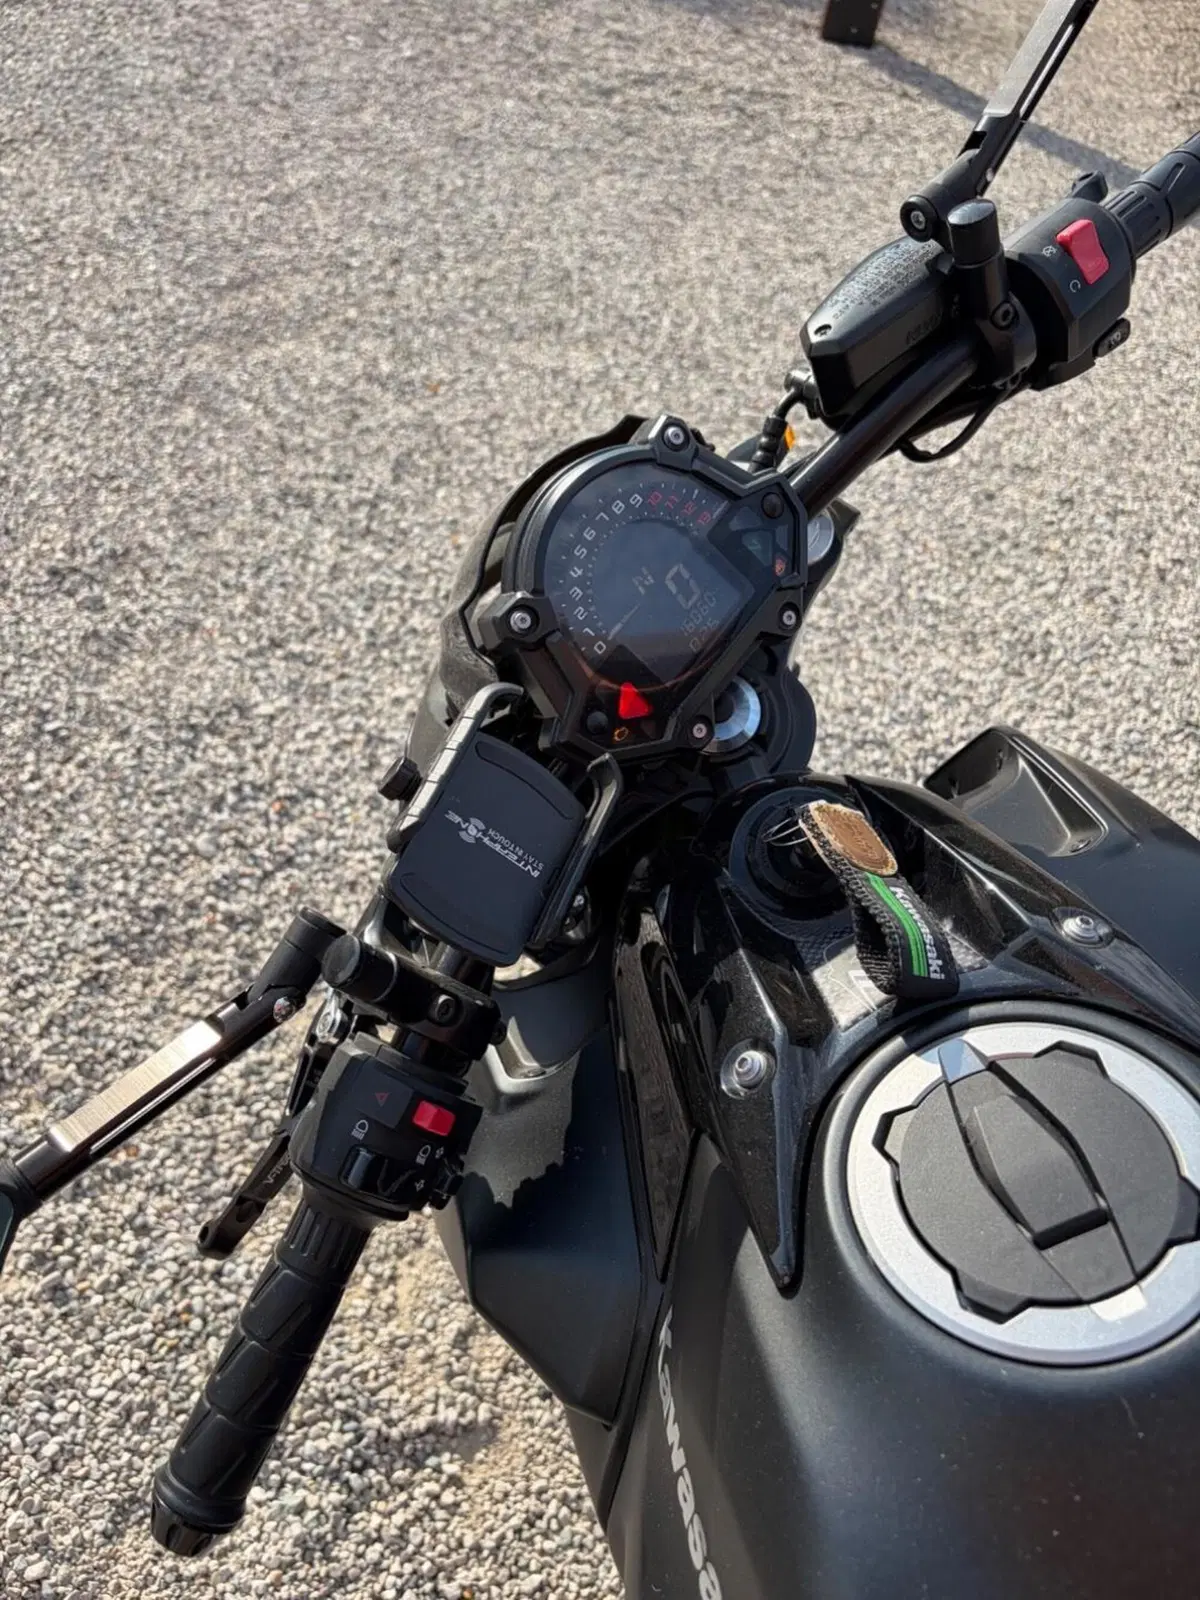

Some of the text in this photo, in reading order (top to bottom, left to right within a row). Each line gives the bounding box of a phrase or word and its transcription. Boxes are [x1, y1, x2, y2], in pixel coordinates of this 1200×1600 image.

[612, 500, 625, 514] 8
[630, 493, 643, 508] 9
[596, 512, 609, 523] 7
[583, 527, 596, 540] 6
[574, 545, 587, 559] 5
[569, 566, 583, 579] 4
[570, 586, 583, 600] 3
[665, 564, 700, 610] 0
[574, 606, 588, 620] 2
[582, 627, 596, 636] 1
[594, 640, 606, 654] 0
[487, 827, 516, 851] TOUCH
[523, 853, 545, 870] STAY
[889, 886, 945, 980] Kawasaki
